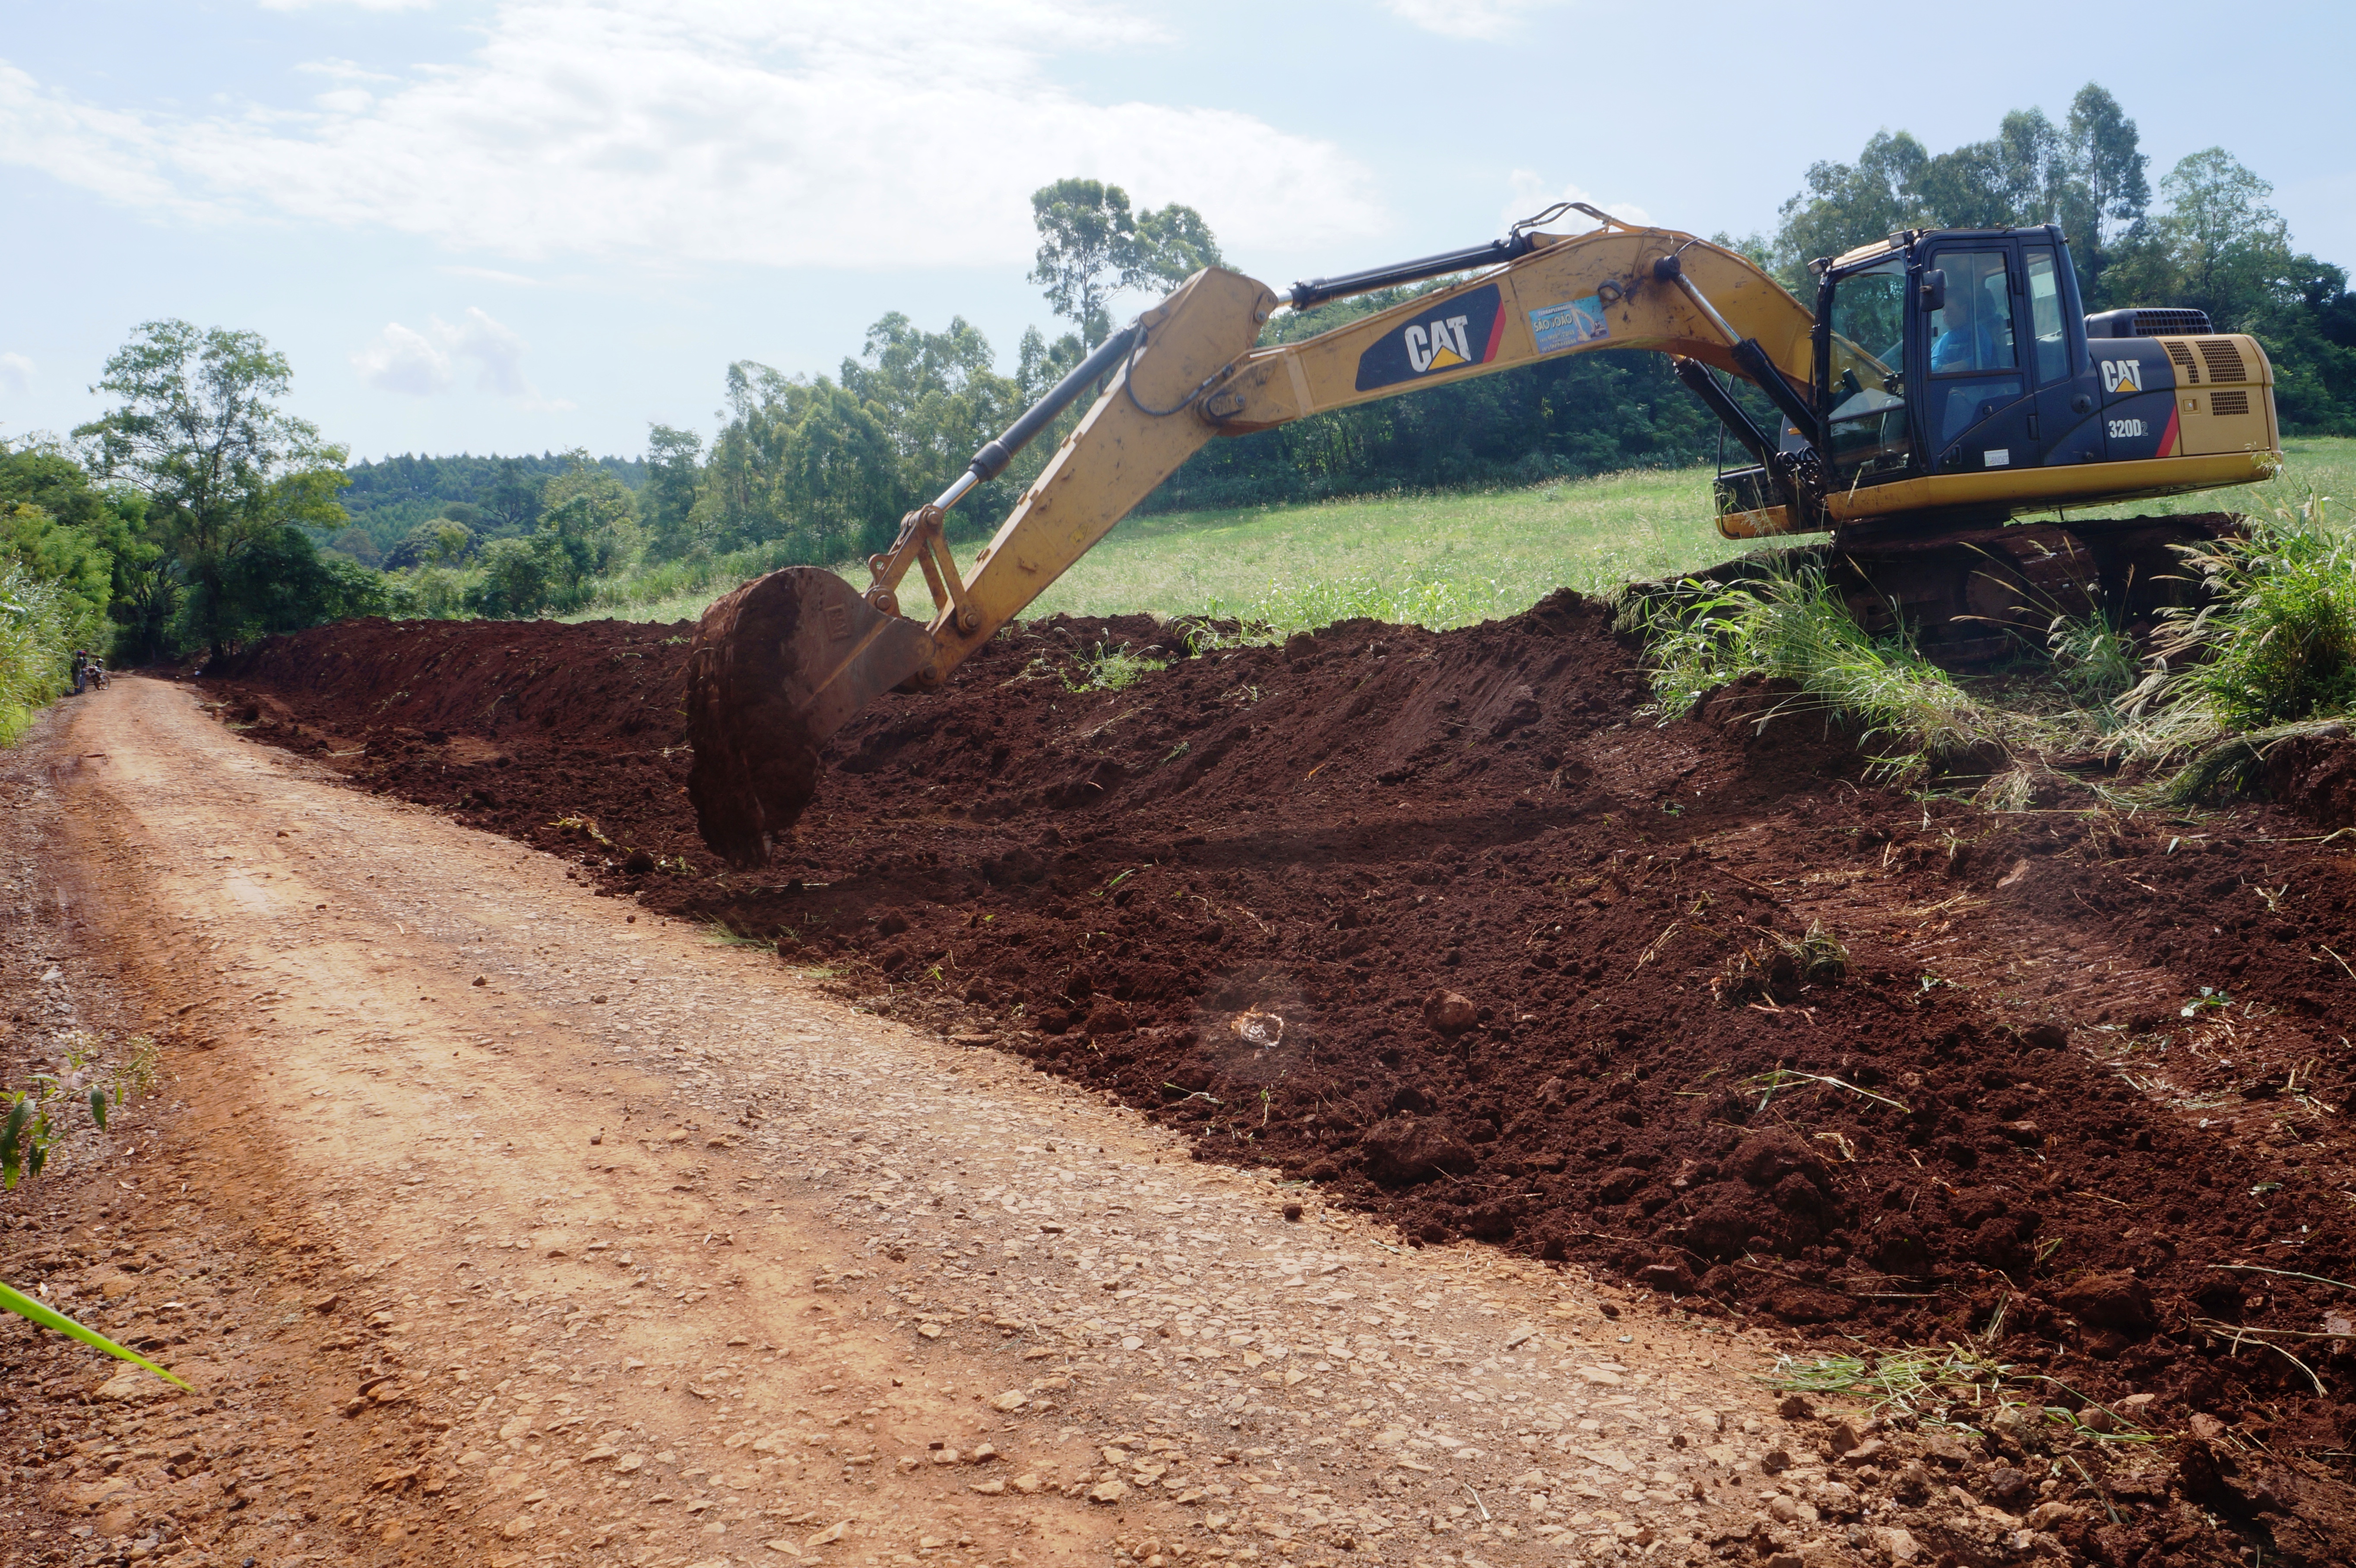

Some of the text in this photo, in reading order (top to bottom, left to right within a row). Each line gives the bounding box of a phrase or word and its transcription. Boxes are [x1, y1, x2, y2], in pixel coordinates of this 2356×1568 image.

[1534, 312, 1573, 332] SÃO JOÃO
[1405, 315, 1471, 372] CAT
[2101, 360, 2142, 392] CAT
[1992, 455, 2008, 465] BNDES
